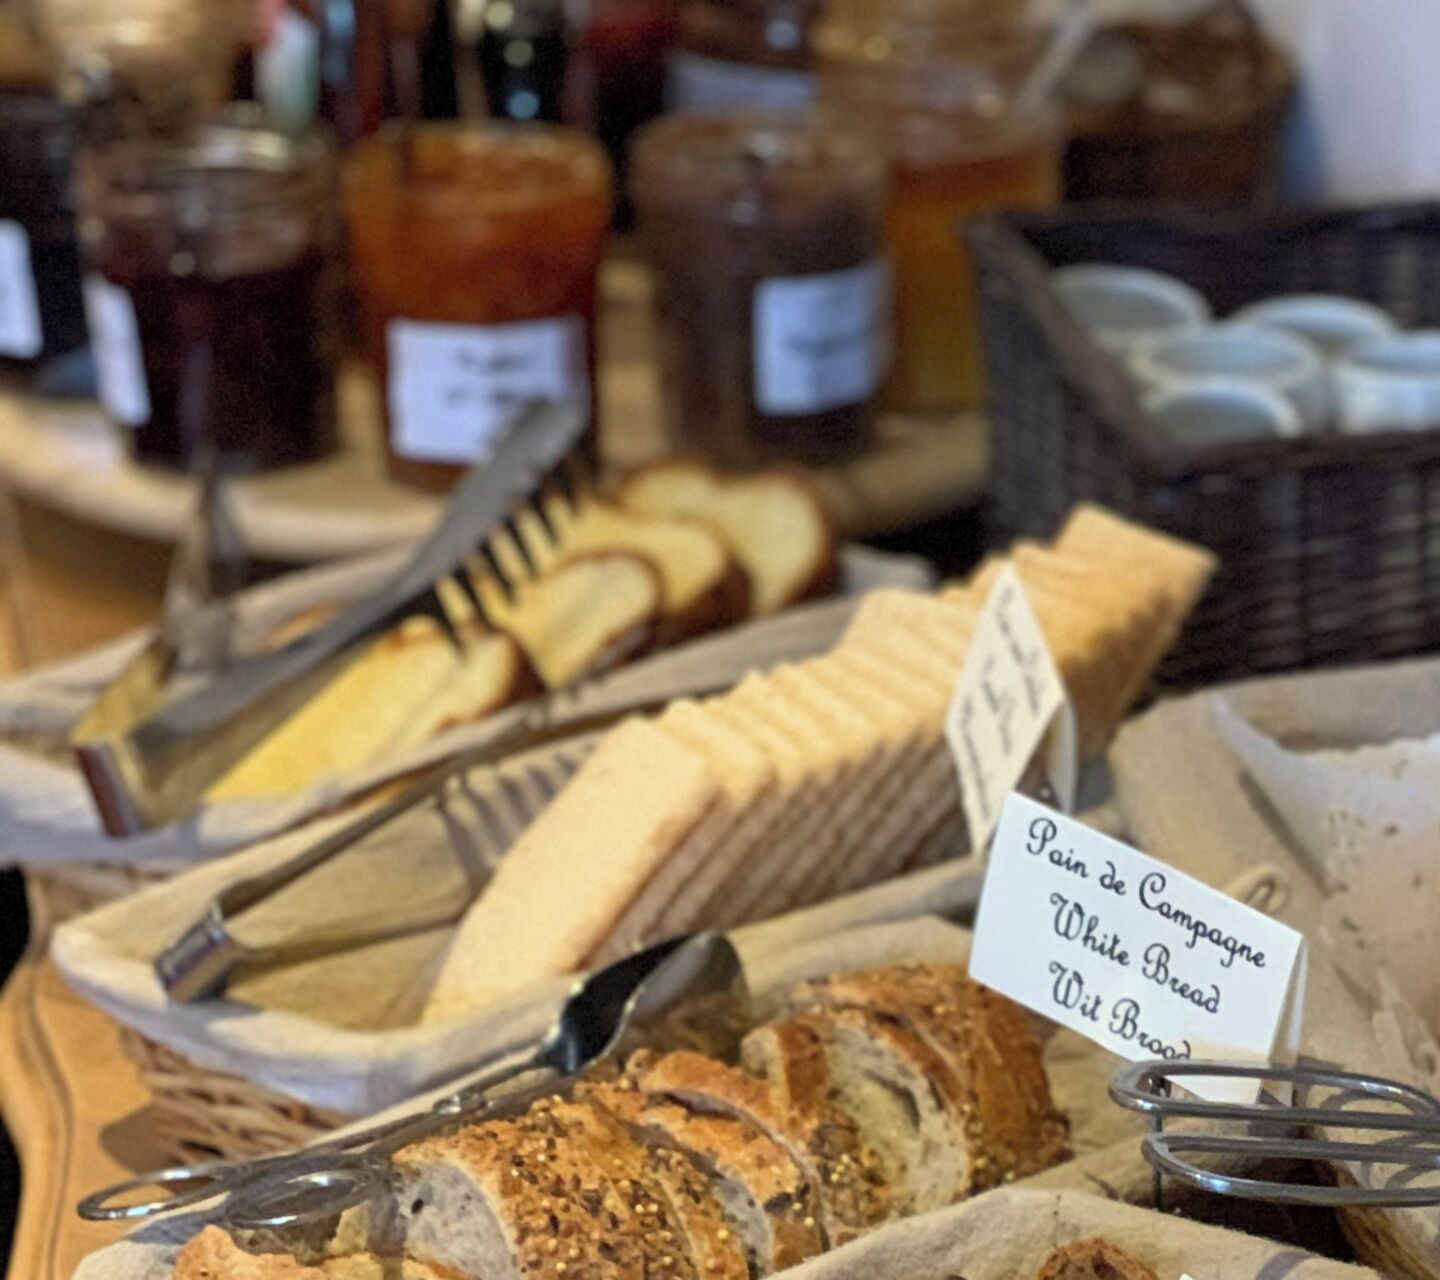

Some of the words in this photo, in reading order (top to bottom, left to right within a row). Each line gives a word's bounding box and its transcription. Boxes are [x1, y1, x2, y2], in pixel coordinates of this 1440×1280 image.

[1026, 817, 1088, 878] Pain
[1100, 861, 1127, 895] de
[1139, 872, 1266, 968] Campagne
[1050, 892, 1130, 966] White
[1142, 943, 1221, 1014] Bread
[1049, 961, 1102, 1021] Wit
